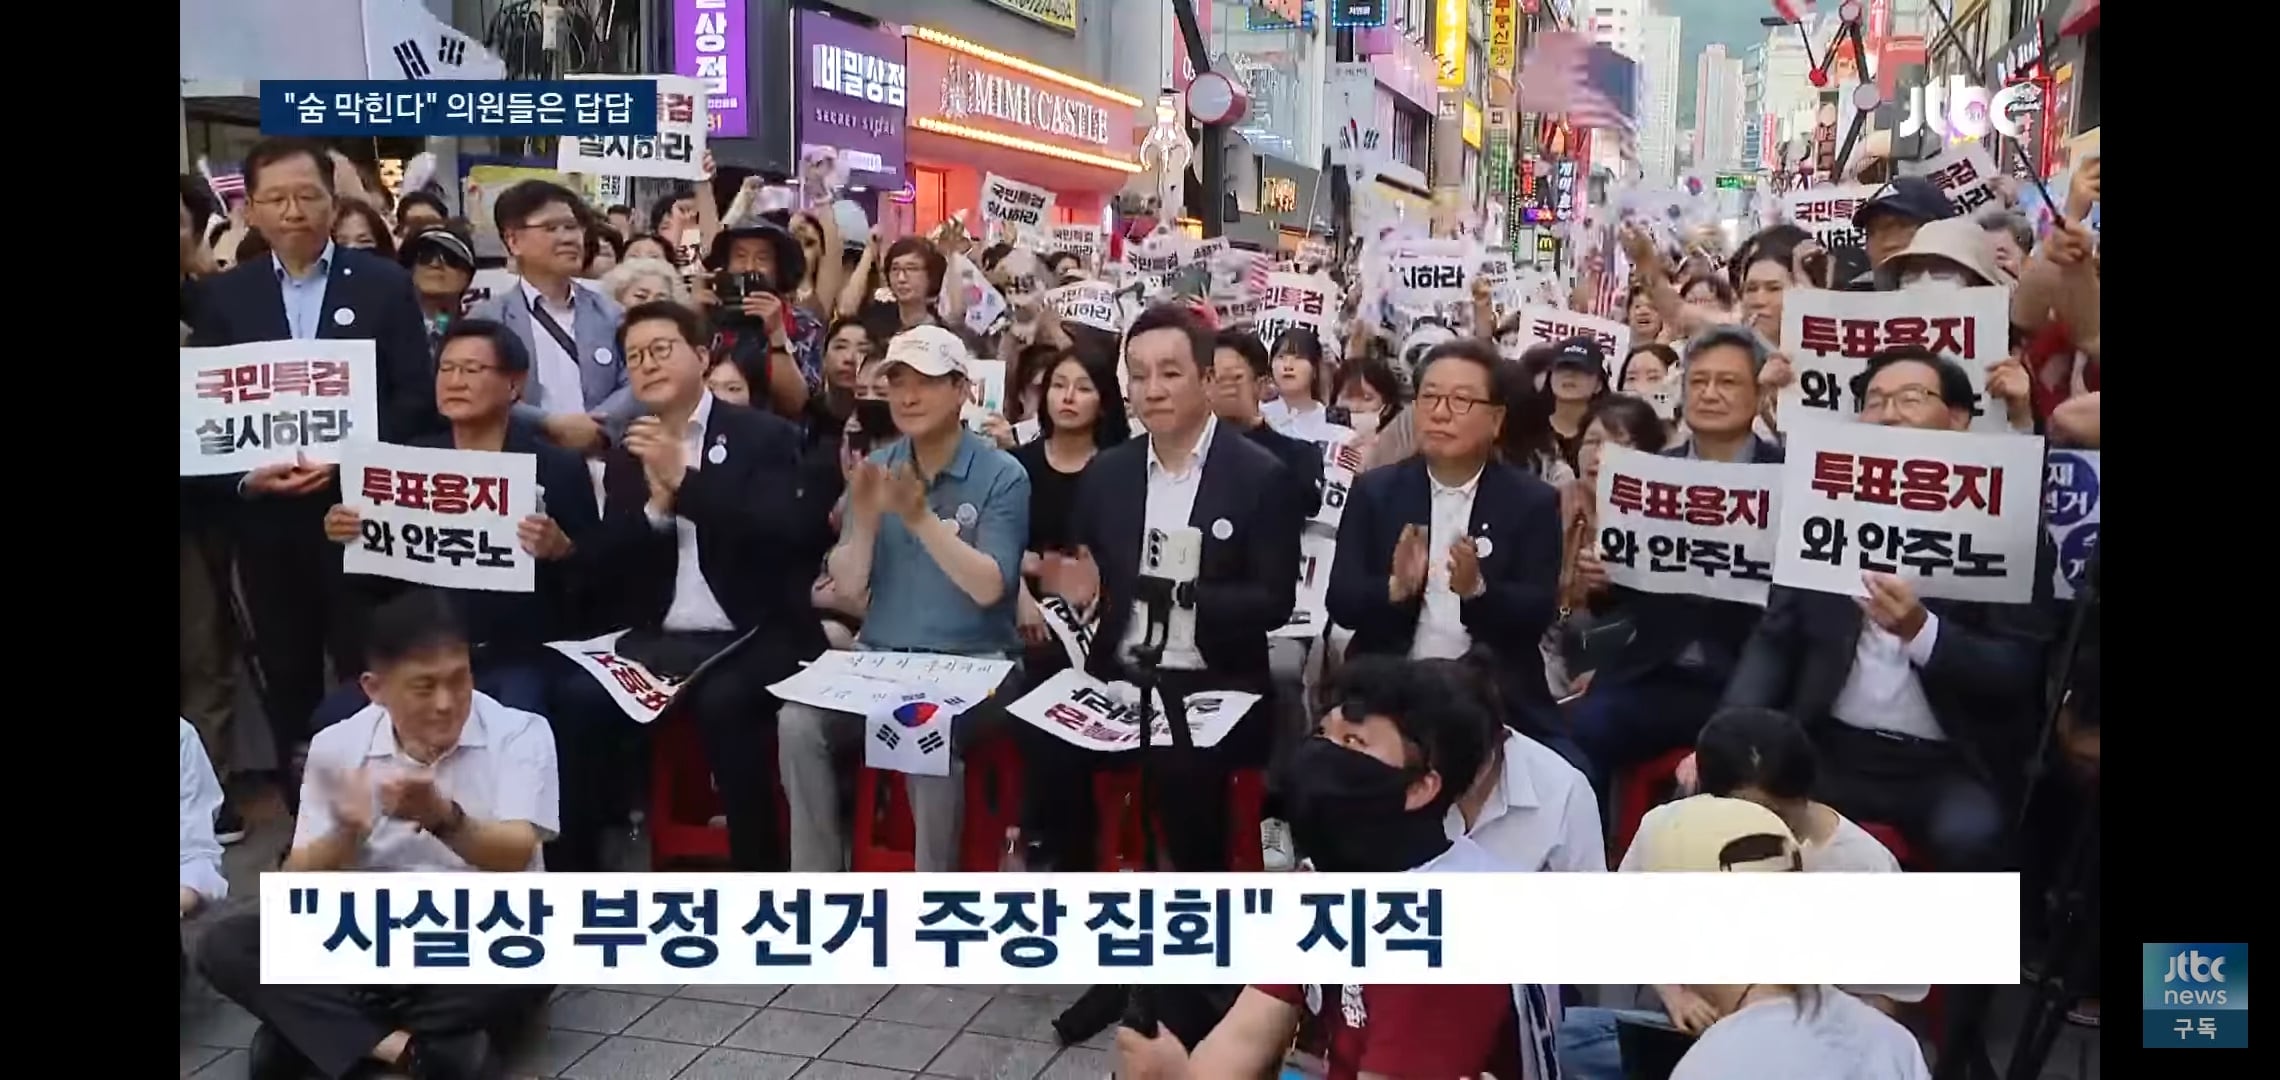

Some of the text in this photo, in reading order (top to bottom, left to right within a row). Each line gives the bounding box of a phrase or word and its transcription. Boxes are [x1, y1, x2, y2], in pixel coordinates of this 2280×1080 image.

[812, 43, 905, 108] 비밀상점
[814, 107, 857, 128] SECRET
[975, 69, 1109, 144] MIMI CASTLE
[1801, 314, 1976, 360] 투표용지
[196, 360, 350, 404] 국민특검
[196, 409, 353, 452] 실시하라
[361, 466, 510, 517] 투표용지
[1609, 472, 1770, 530] 투표용지
[1811, 451, 2003, 517] 투표용지
[361, 519, 515, 569] 와 안주노
[1601, 526, 1774, 582] 와 안주노
[1801, 515, 1848, 566] 와
[1858, 521, 2008, 579] 안주노
